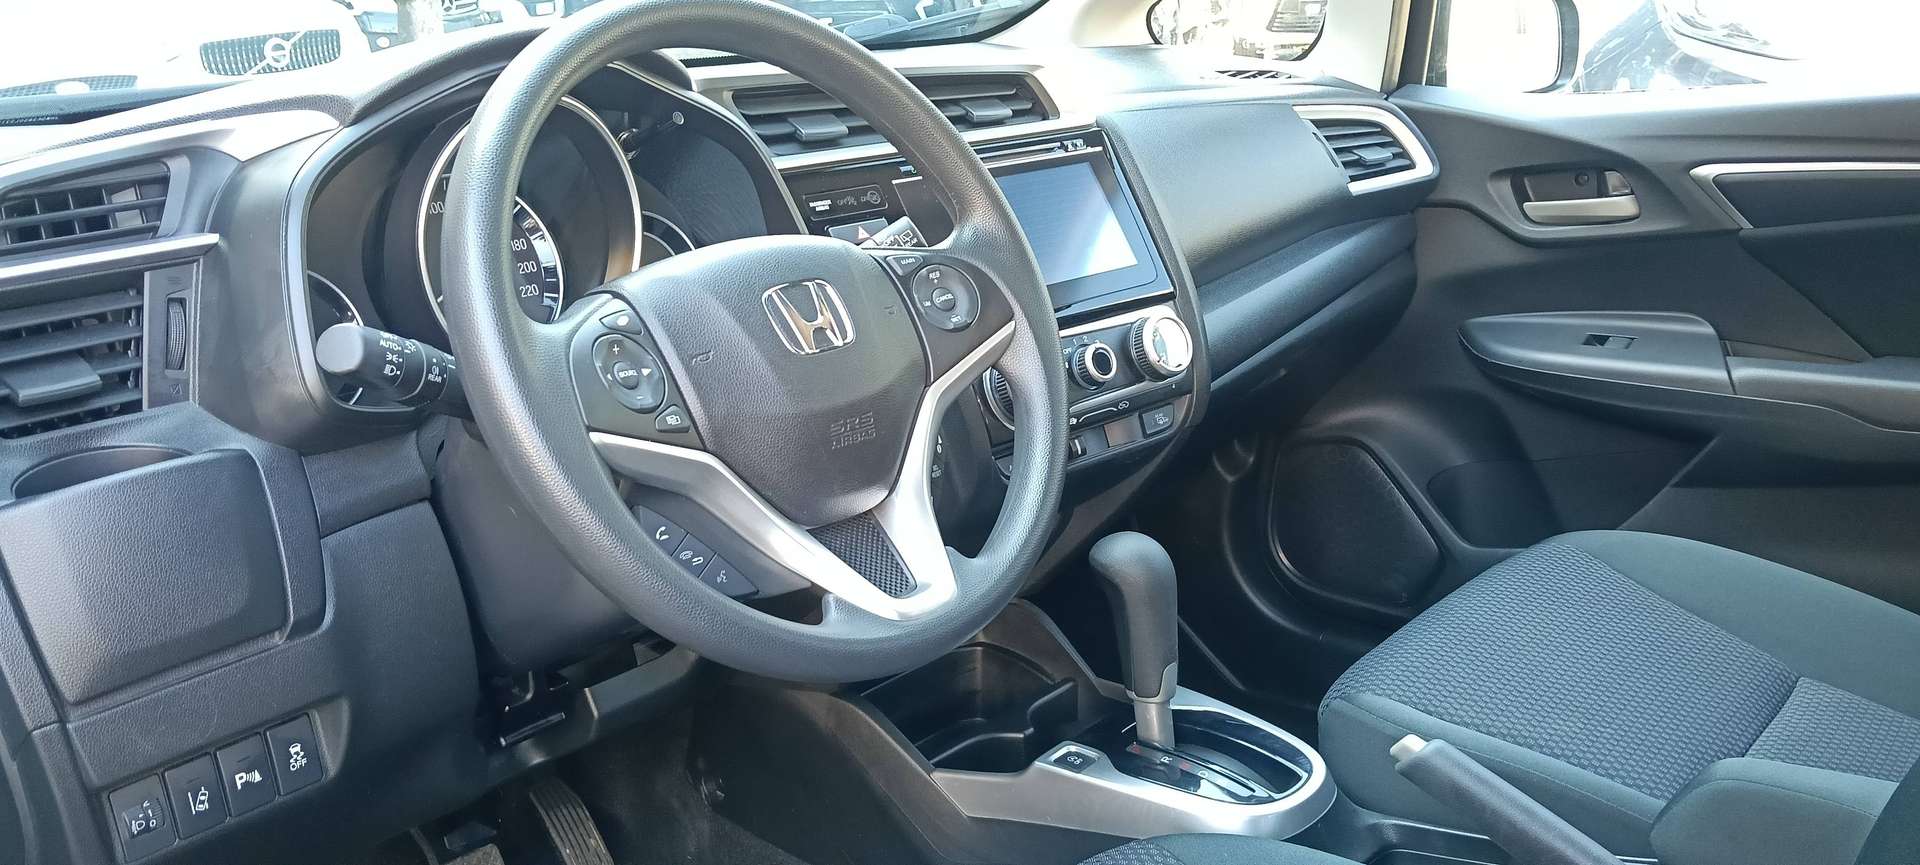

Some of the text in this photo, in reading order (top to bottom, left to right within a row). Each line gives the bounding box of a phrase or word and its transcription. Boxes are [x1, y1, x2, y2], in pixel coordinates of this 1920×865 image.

[511, 238, 527, 251] 180
[518, 260, 537, 274] 200
[520, 283, 539, 298] 220
[380, 339, 399, 351] AUTO
[427, 373, 442, 384] REAR
[830, 411, 876, 438] SRS
[290, 758, 307, 771] OFF
[1160, 756, 1173, 764] R
